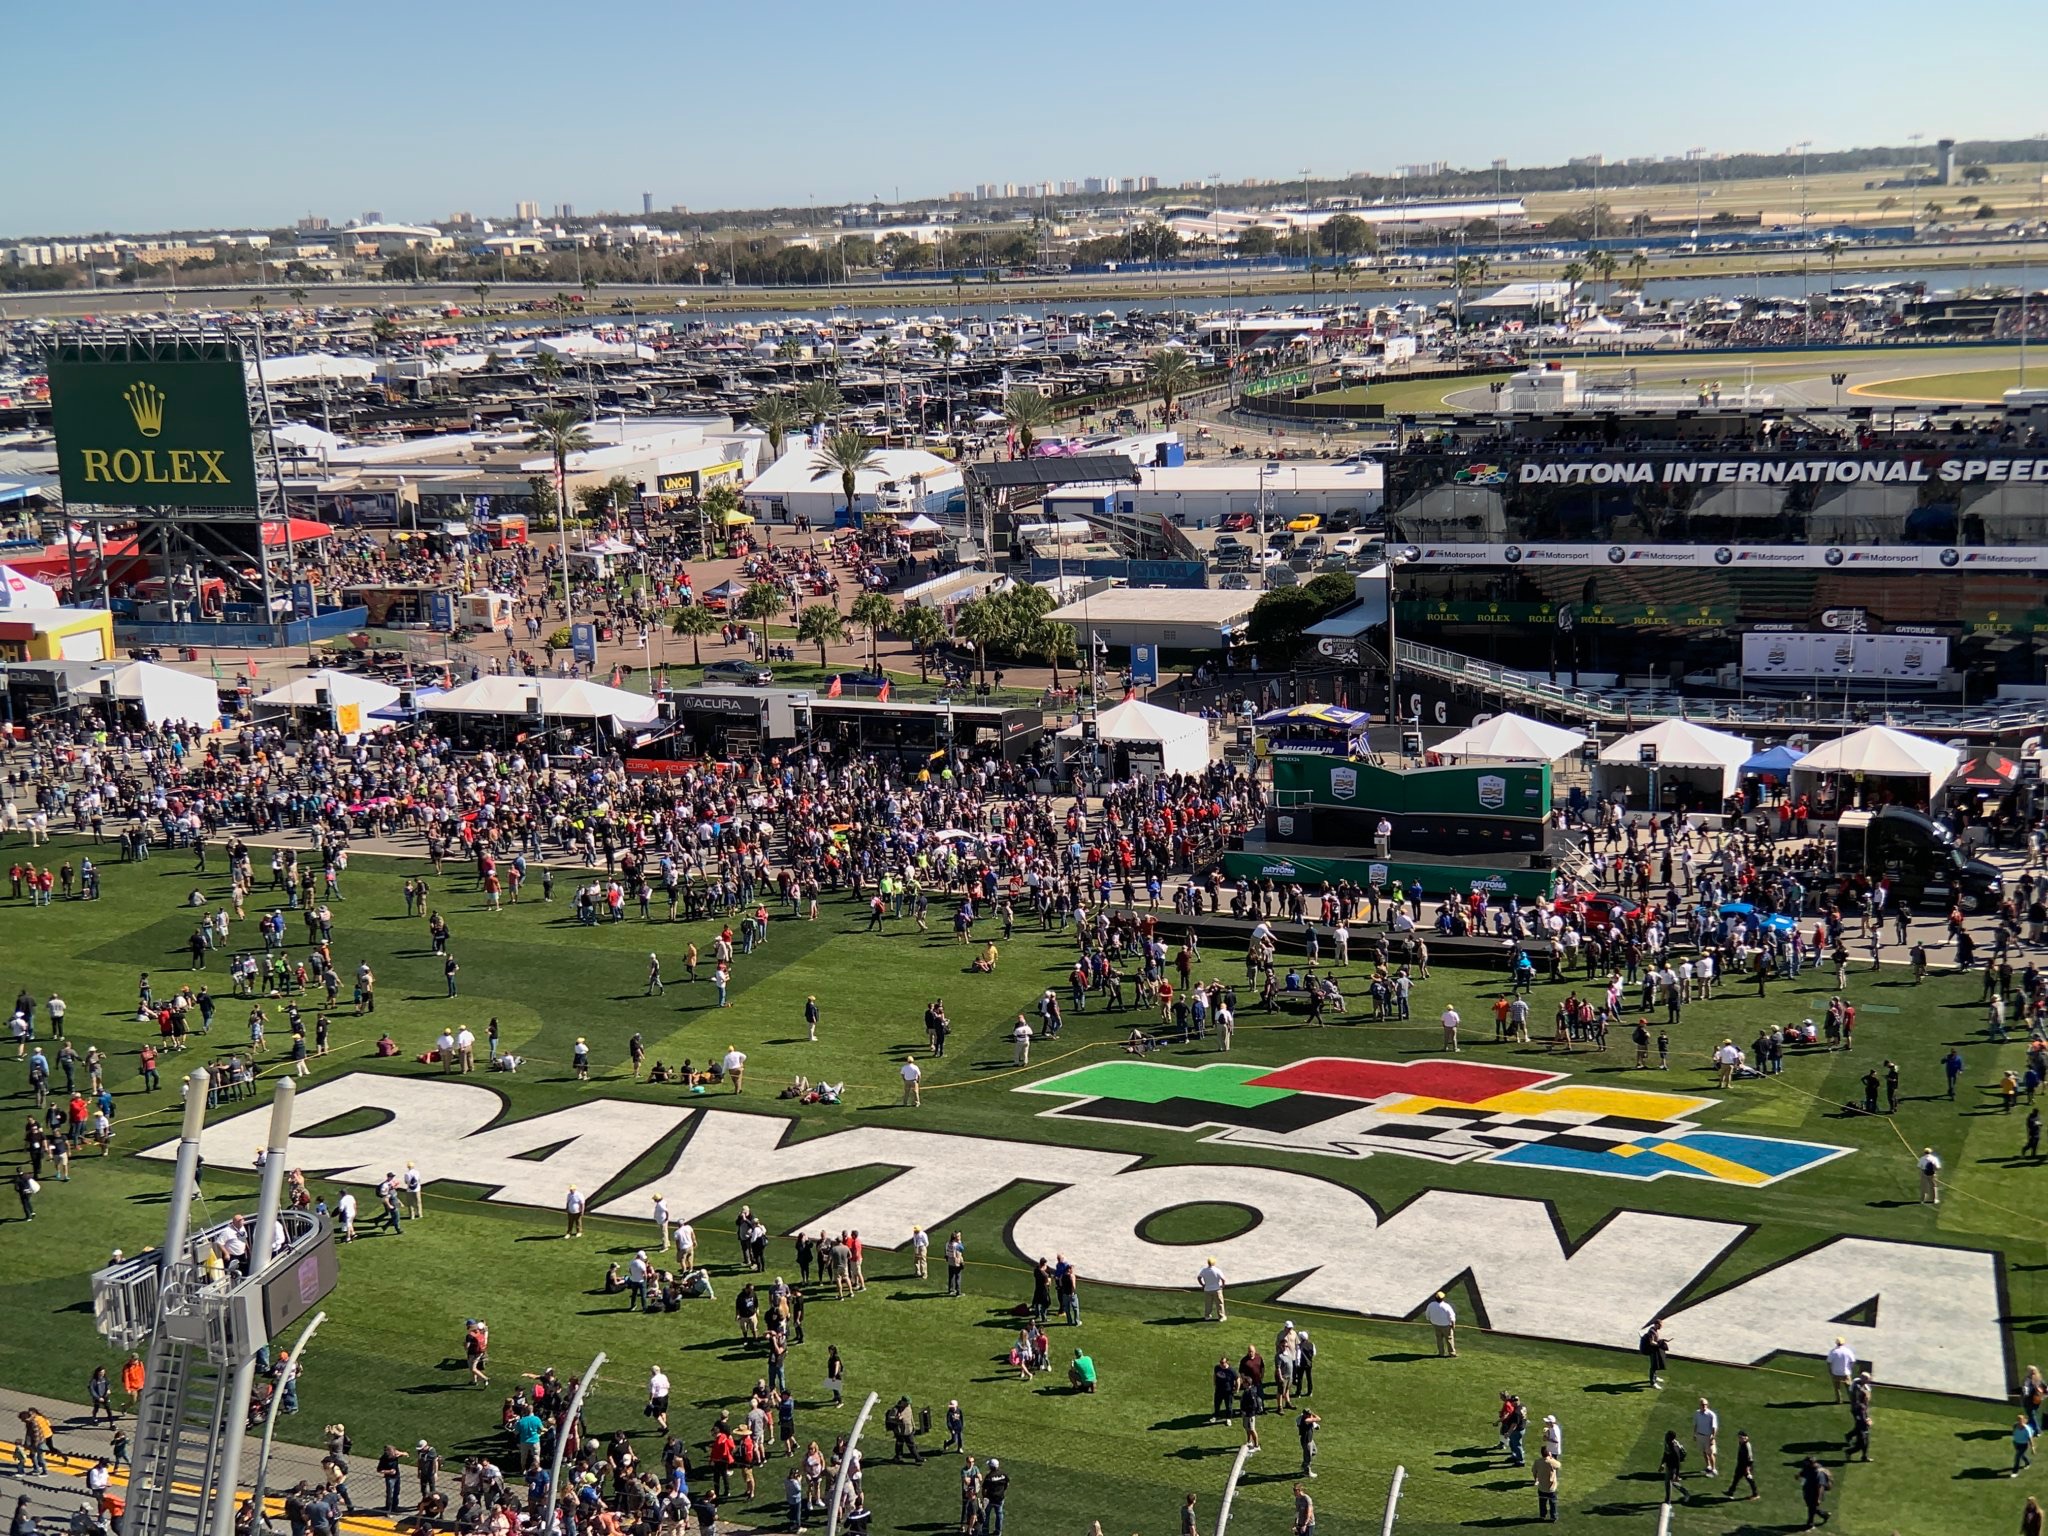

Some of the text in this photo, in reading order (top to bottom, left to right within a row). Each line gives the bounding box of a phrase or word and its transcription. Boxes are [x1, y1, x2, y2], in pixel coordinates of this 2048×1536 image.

[81, 448, 231, 484] ROLEX
[1519, 462, 1655, 483] DAYTONA
[1662, 460, 1930, 483] INTERNATIONAL
[664, 476, 692, 489] UNOH
[1444, 551, 1486, 561] Motorsport
[1545, 551, 1589, 561] Motorsport
[1650, 552, 1695, 562] Motorsport
[1758, 553, 1805, 563] Motorsport
[1870, 553, 1919, 564] Motorsport
[1987, 554, 2037, 565] Motorsport
[1427, 613, 1460, 622] ROLEX
[1477, 614, 1510, 622] ROLEX
[1528, 615, 1556, 623] ROLE
[1580, 616, 1615, 624] ROLEX
[1634, 617, 1669, 625] ROLEX
[1687, 618, 1723, 626] ROLEX
[1821, 610, 1839, 628] G
[1753, 623, 1793, 632] GATORADE
[1895, 625, 1936, 634] GATORADE
[1973, 623, 2013, 632] ROLEX
[1318, 637, 1333, 656] G
[9, 673, 41, 683] CURA
[692, 700, 742, 710] ACURA
[1410, 693, 1422, 716] G
[1434, 701, 1447, 724] G
[1282, 745, 1335, 754] MICHELIN
[625, 762, 650, 770] CURA
[1334, 779, 1355, 788] 24
[1481, 787, 1503, 796] 24
[1262, 866, 1296, 875] DAYTONA
[1470, 880, 1507, 890] DAYTONA
[137, 1071, 2010, 1404] DAYTONA
